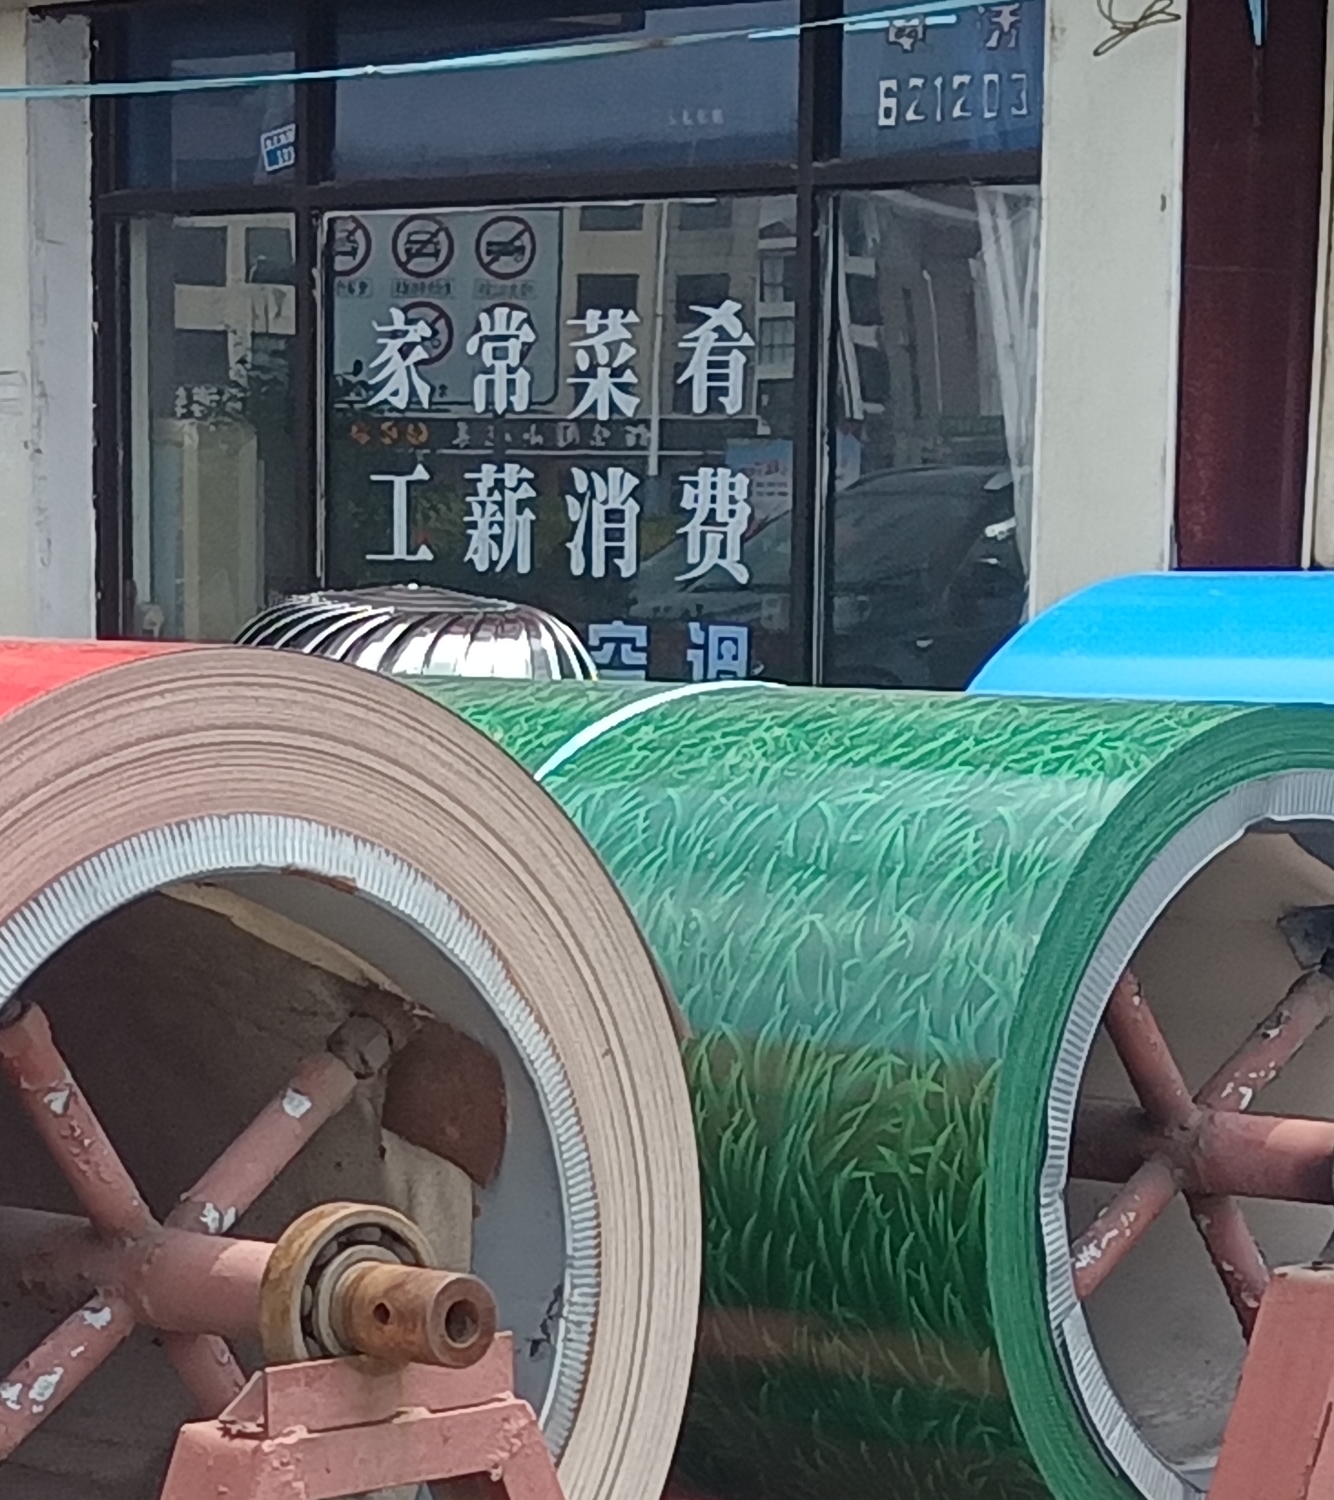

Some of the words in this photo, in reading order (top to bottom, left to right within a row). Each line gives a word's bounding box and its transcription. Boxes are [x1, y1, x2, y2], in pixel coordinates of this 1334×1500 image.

[877, 72, 1028, 127] 621203
[366, 299, 756, 421] 家常菜肴
[365, 462, 752, 585] 工薪消费
[587, 619, 749, 681] 空调
